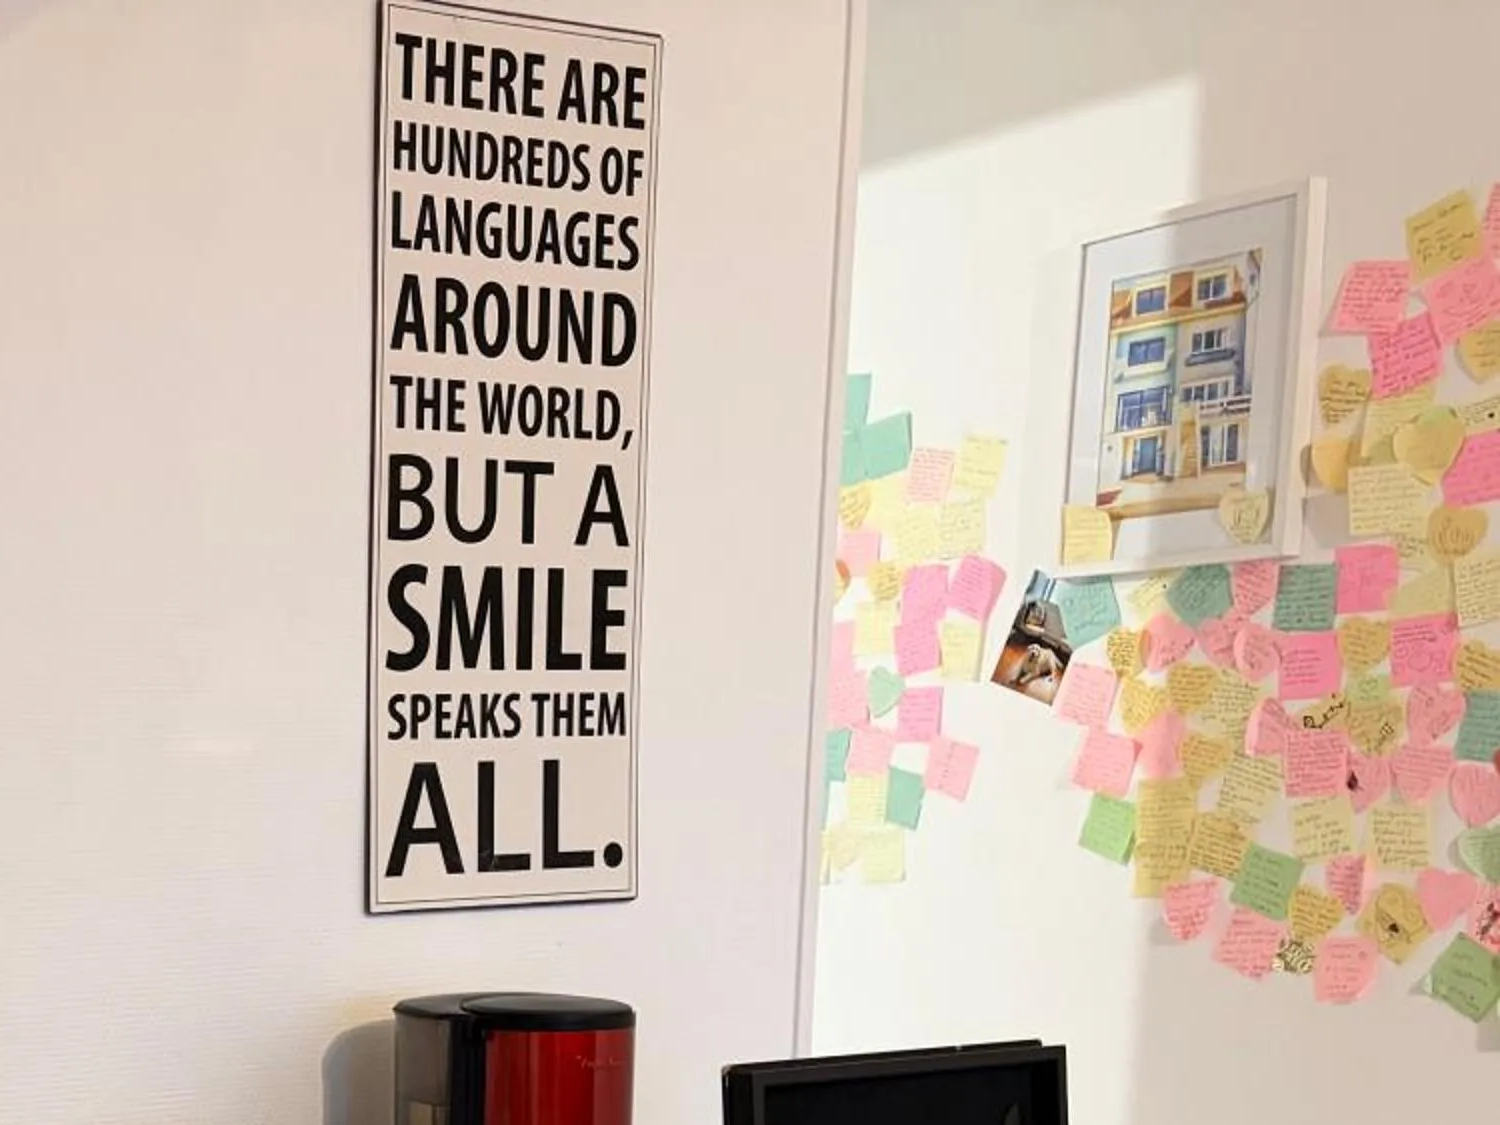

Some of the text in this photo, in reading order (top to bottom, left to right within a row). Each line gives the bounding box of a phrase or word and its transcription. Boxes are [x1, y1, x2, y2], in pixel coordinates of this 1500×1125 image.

[395, 31, 647, 131] THERE ARE
[393, 119, 645, 197] HUNDREDS OF
[391, 190, 640, 271] LANGUAGES
[390, 273, 637, 367] AROUND
[389, 375, 633, 451] THE WORLD,
[387, 453, 630, 547] BUT A
[385, 563, 629, 672] SMILE
[387, 691, 626, 741] SPEAKS THEM
[385, 759, 623, 878] ALL.
